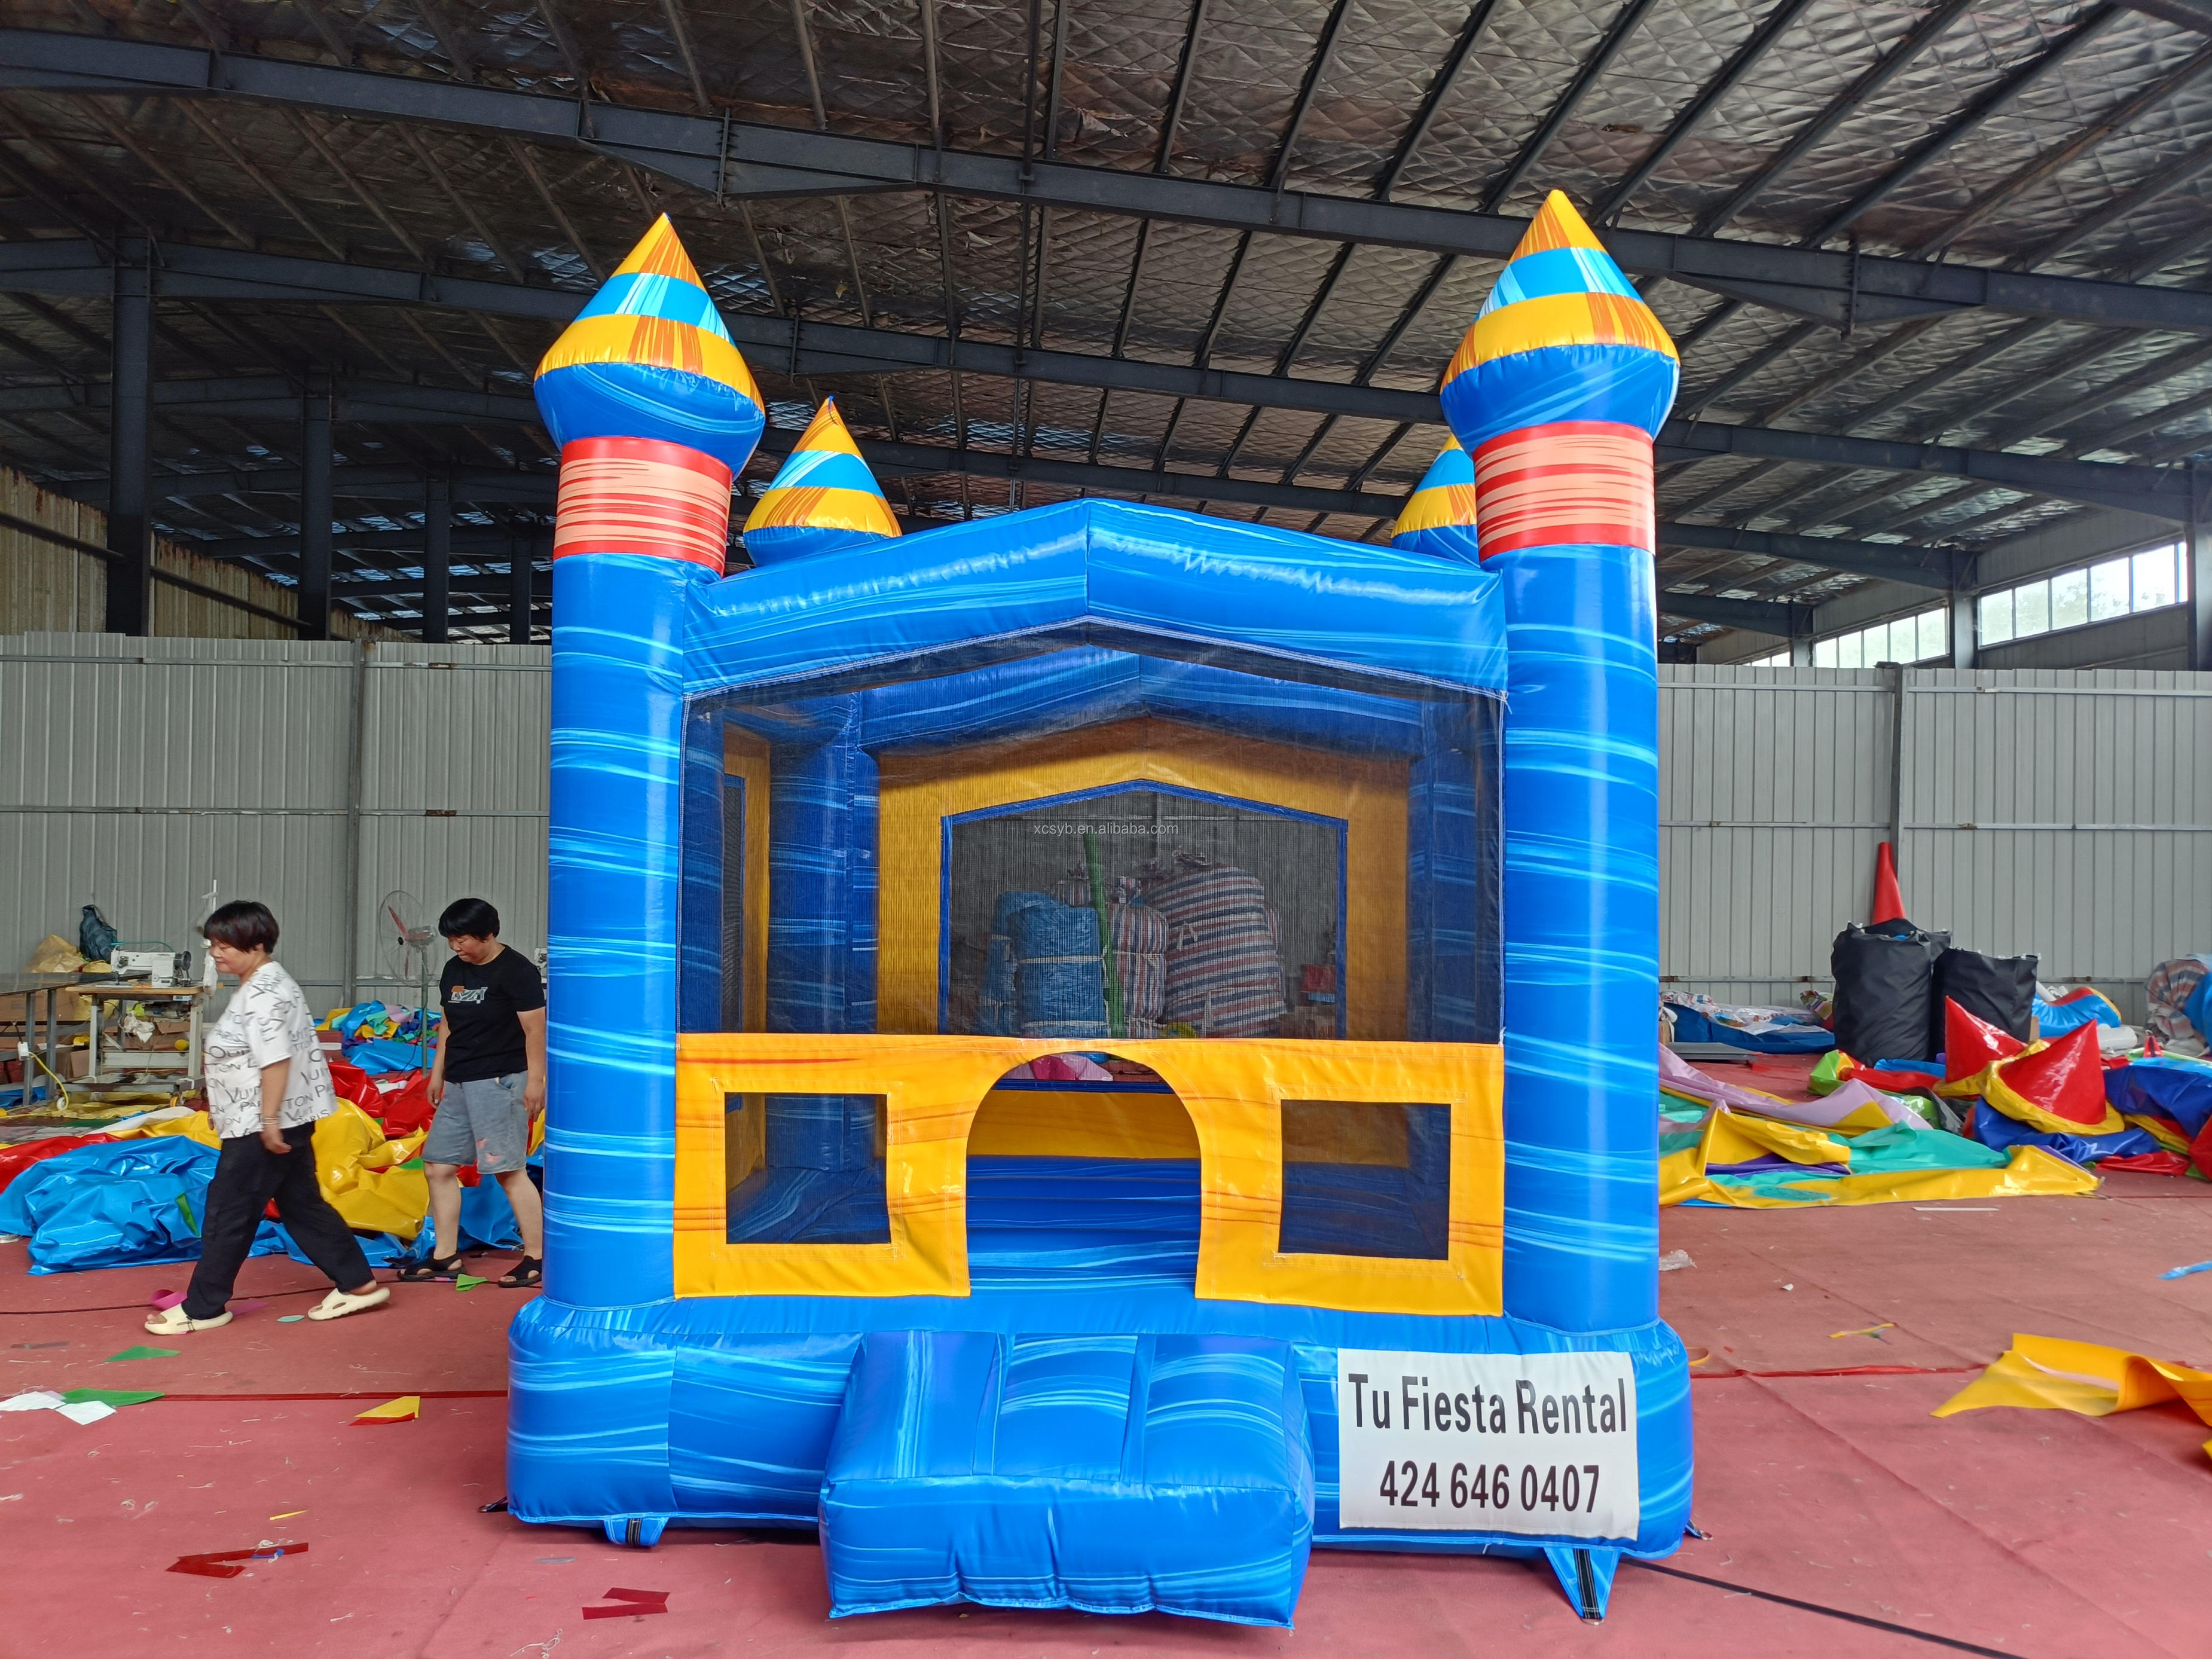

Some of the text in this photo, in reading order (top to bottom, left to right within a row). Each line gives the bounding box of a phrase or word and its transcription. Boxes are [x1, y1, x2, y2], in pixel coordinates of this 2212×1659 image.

[1348, 1373, 1627, 1434] Tu Fiesta Rental
[1380, 1461, 1600, 1513] 424 646 0407
